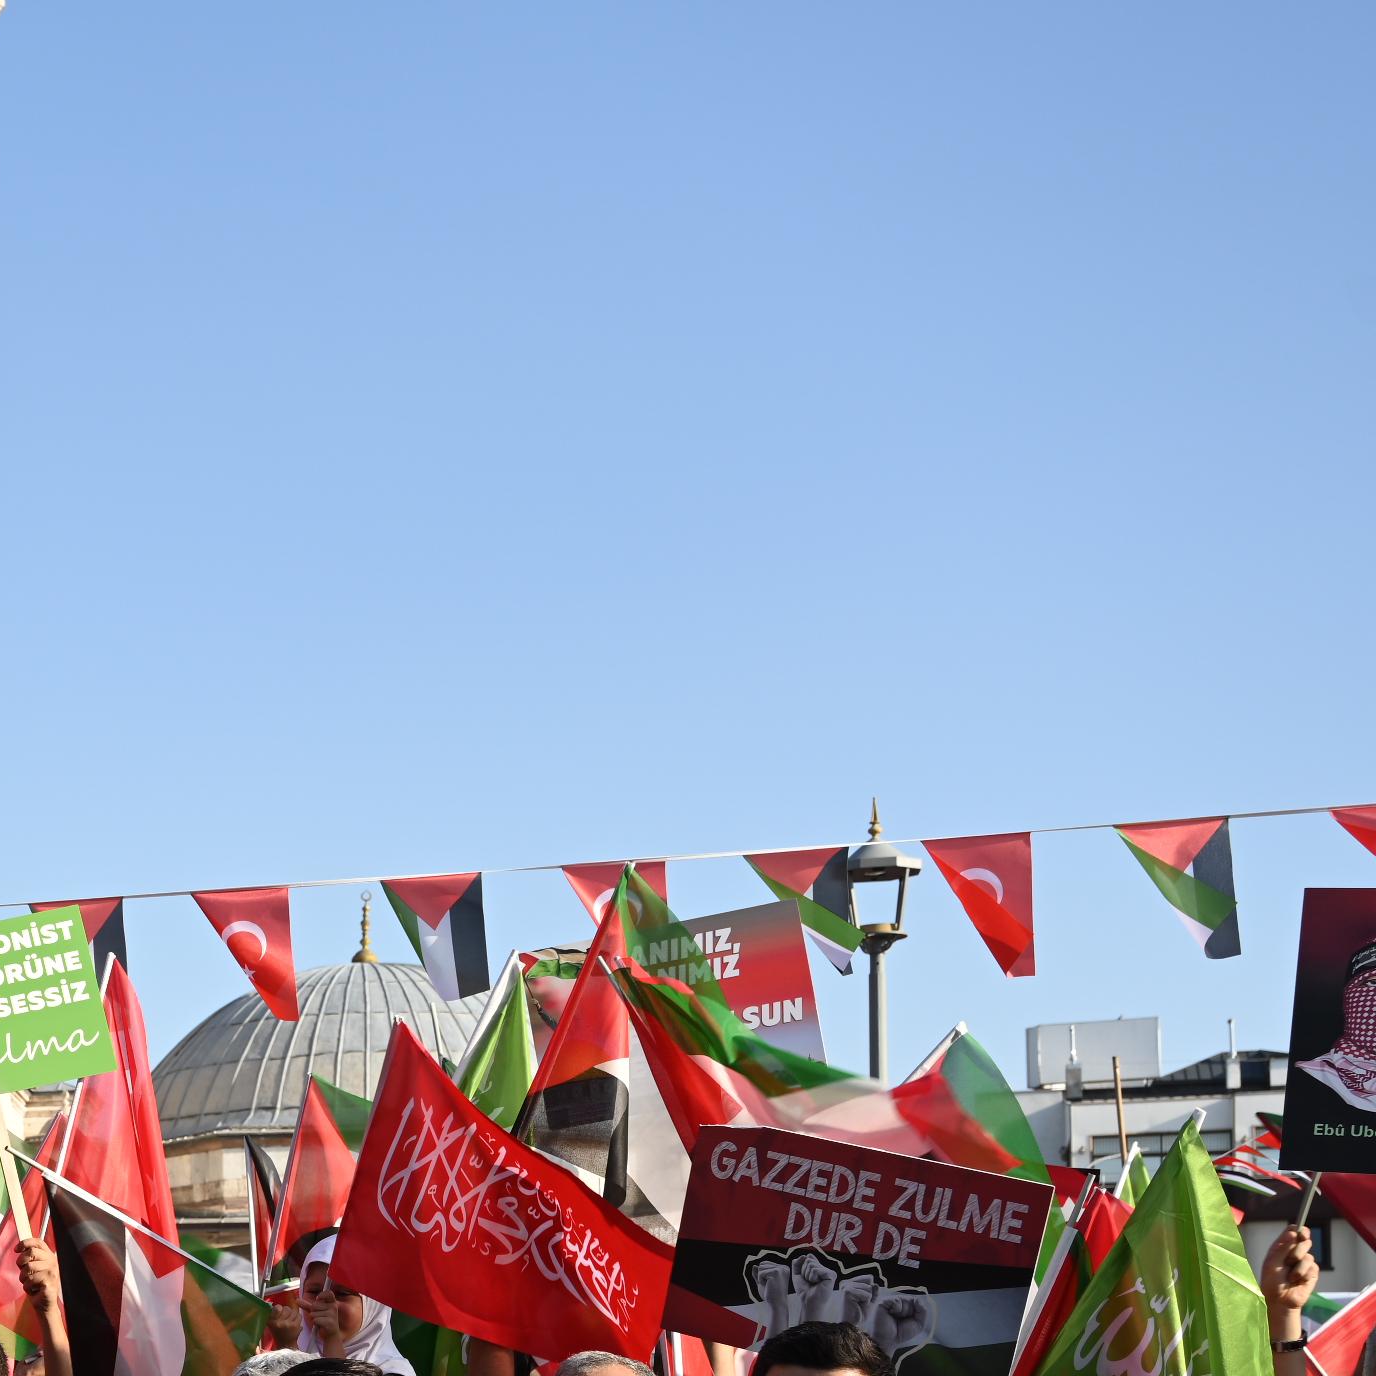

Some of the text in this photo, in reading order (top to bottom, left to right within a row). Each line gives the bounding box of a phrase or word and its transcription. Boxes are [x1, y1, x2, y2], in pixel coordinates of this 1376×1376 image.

[631, 927, 741, 967] ANIMIZ,
[1313, 1122, 1345, 1137] Ebû
[710, 1140, 1029, 1244] GAZZEDE ZULME
[783, 1201, 927, 1269] DUR DE
